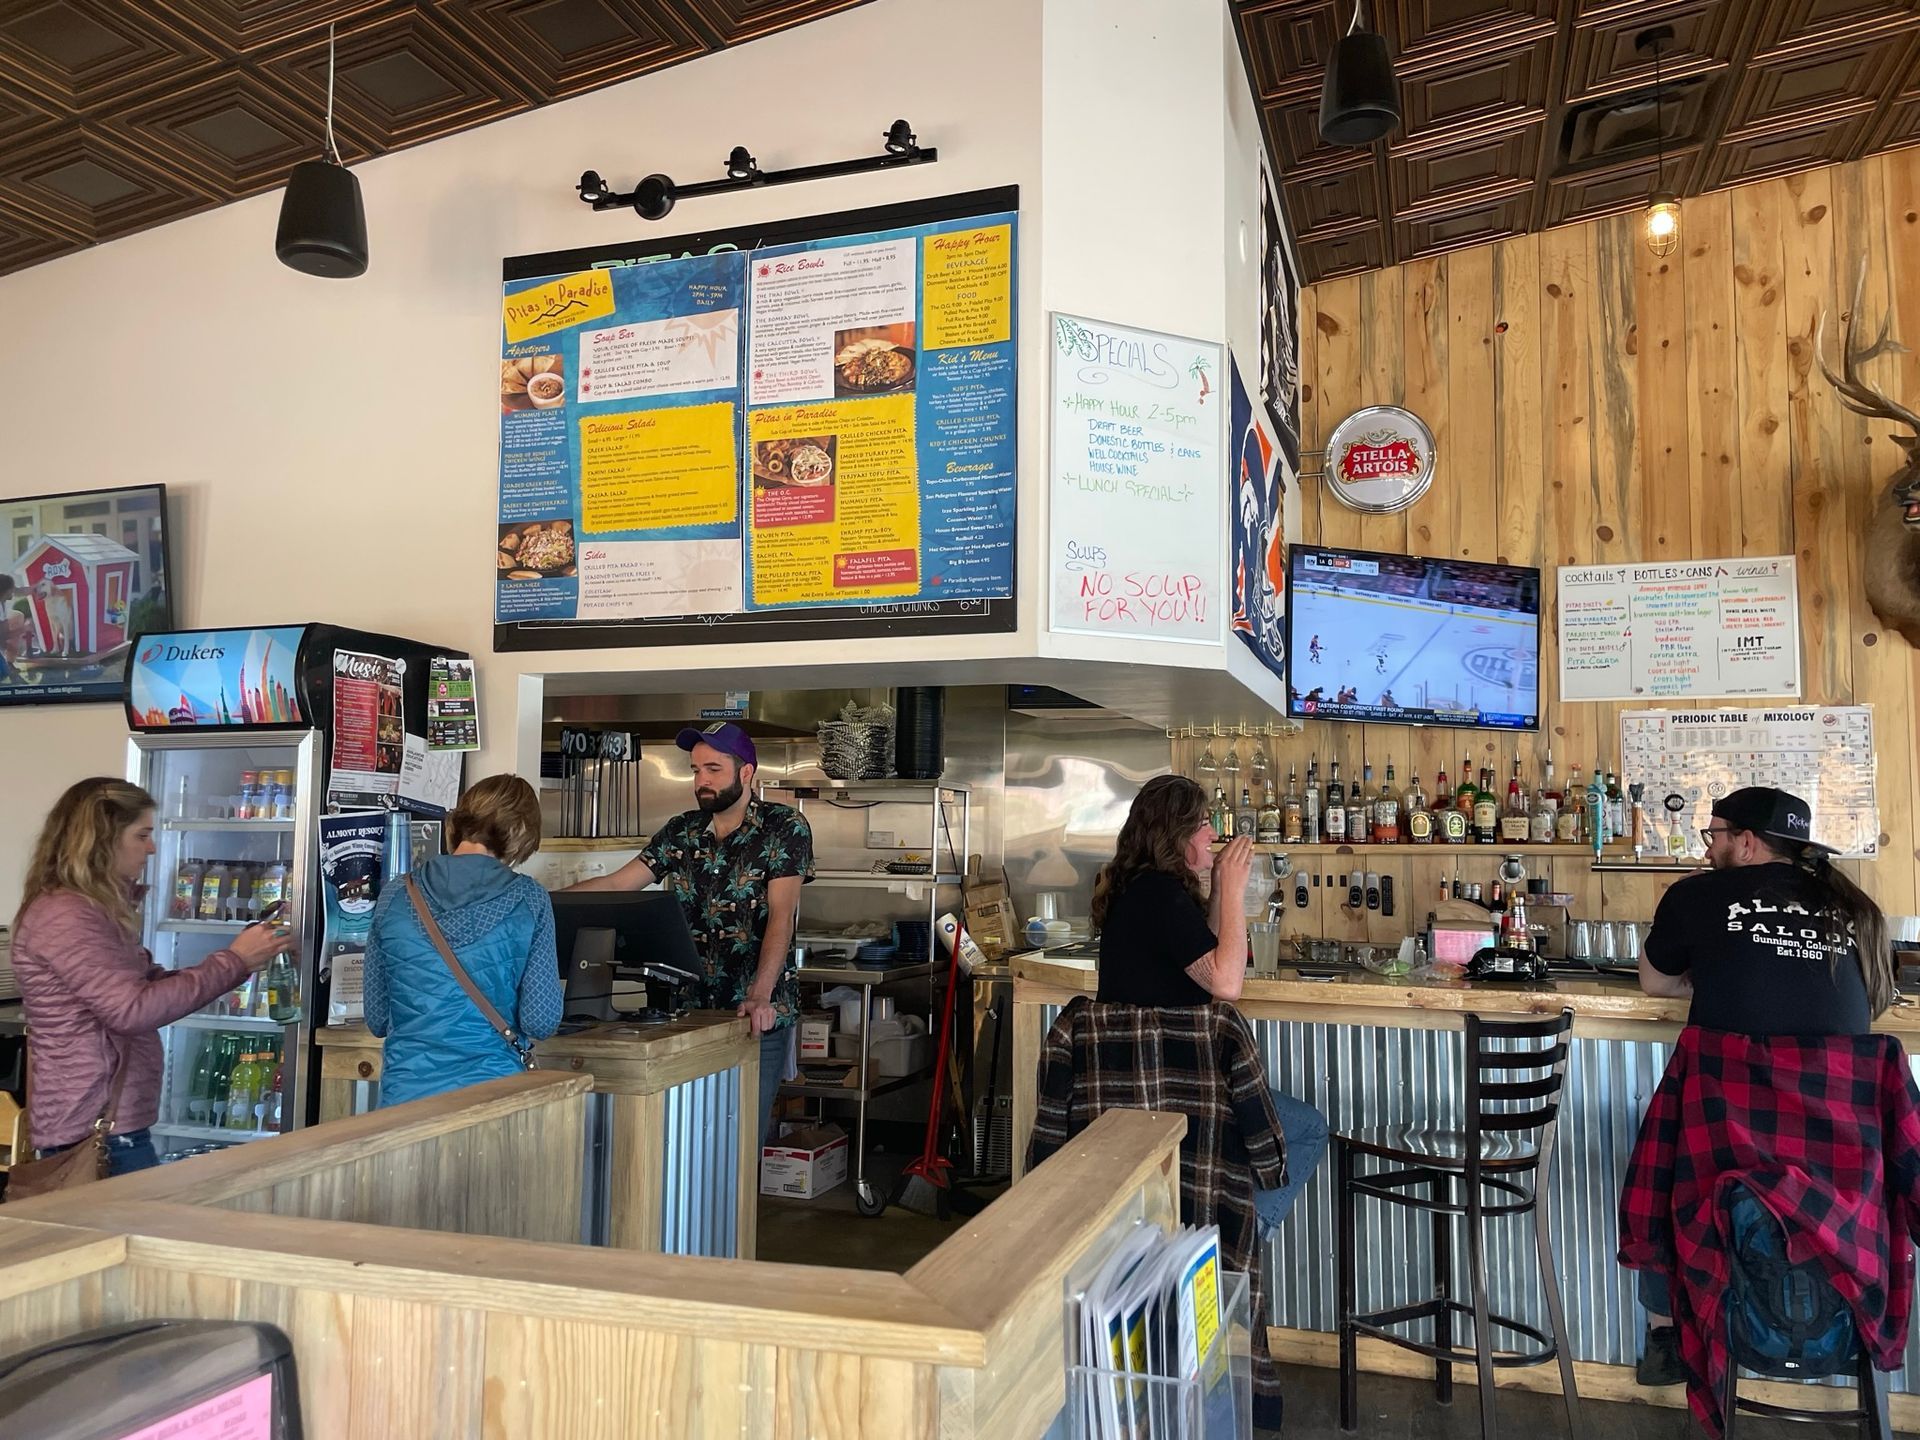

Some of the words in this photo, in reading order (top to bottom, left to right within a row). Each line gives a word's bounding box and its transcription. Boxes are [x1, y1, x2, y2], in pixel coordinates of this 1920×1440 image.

[934, 238, 970, 252] Happy
[973, 232, 1000, 244] Hour
[775, 263, 794, 274] Rice
[798, 258, 824, 270] Bowls
[946, 258, 988, 269] BEVERAGES
[507, 304, 540, 323] Pitas
[544, 295, 554, 306] in
[558, 278, 608, 302] Paradise
[957, 292, 977, 300] FOOD
[594, 333, 616, 344] Soup
[620, 328, 634, 340] Bar
[506, 344, 550, 357] Appetizers
[938, 352, 966, 364] Kid's
[969, 350, 998, 362] Menu
[1077, 328, 1178, 382] SPECIALS
[755, 412, 780, 424] Pitas
[784, 412, 792, 421] in
[796, 408, 837, 422] Paradise
[1074, 392, 1105, 414] HAPPY
[1110, 400, 1140, 418] HOUR
[1148, 404, 1197, 429] 2-5pm
[588, 423, 624, 434] Delicious
[626, 418, 656, 430] Salads
[1088, 418, 1117, 432] DRAFT
[1120, 422, 1144, 436] BEER
[948, 438, 978, 446] CHICKEN
[980, 434, 1006, 442] CHUNKS
[1089, 434, 1129, 448] DOMESTIC
[1132, 439, 1165, 452] BOTTLES
[1178, 448, 1201, 458] CANS
[1088, 447, 1107, 461] WELL
[1108, 450, 1150, 464] COCKTAILS
[1352, 449, 1408, 462] STELLA
[946, 462, 994, 474] Beverages
[1089, 460, 1114, 475] HOUSE
[1116, 463, 1140, 476] WINE
[1352, 460, 1408, 474] ARTOIS
[1078, 474, 1118, 492] LUNCH
[1126, 480, 1182, 502] SPECIAL
[584, 550, 606, 562] Sides
[1066, 540, 1107, 561] SOUPS
[47, 562, 70, 578] ROXY
[1565, 570, 1614, 582] cocktails
[1634, 568, 1678, 580] BOTTLES
[1686, 566, 1712, 578] CANS
[1736, 564, 1769, 576] wines
[1080, 572, 1112, 597] NO
[1125, 572, 1201, 602] SOUP
[1085, 598, 1137, 622] FOR
[1140, 594, 1206, 626] YOU!!
[1738, 636, 1764, 648] IMT
[166, 644, 226, 662] Dukers
[337, 654, 382, 677] Music
[1340, 704, 1372, 712] CONFERENCE
[1672, 714, 1716, 724] PERIODIC
[1720, 714, 1748, 722] TABLE
[1764, 712, 1815, 722] MIXOLOGY
[326, 828, 356, 839] ALMONT
[358, 826, 384, 838] RESORT
[1752, 934, 1802, 949] Gunnison,
